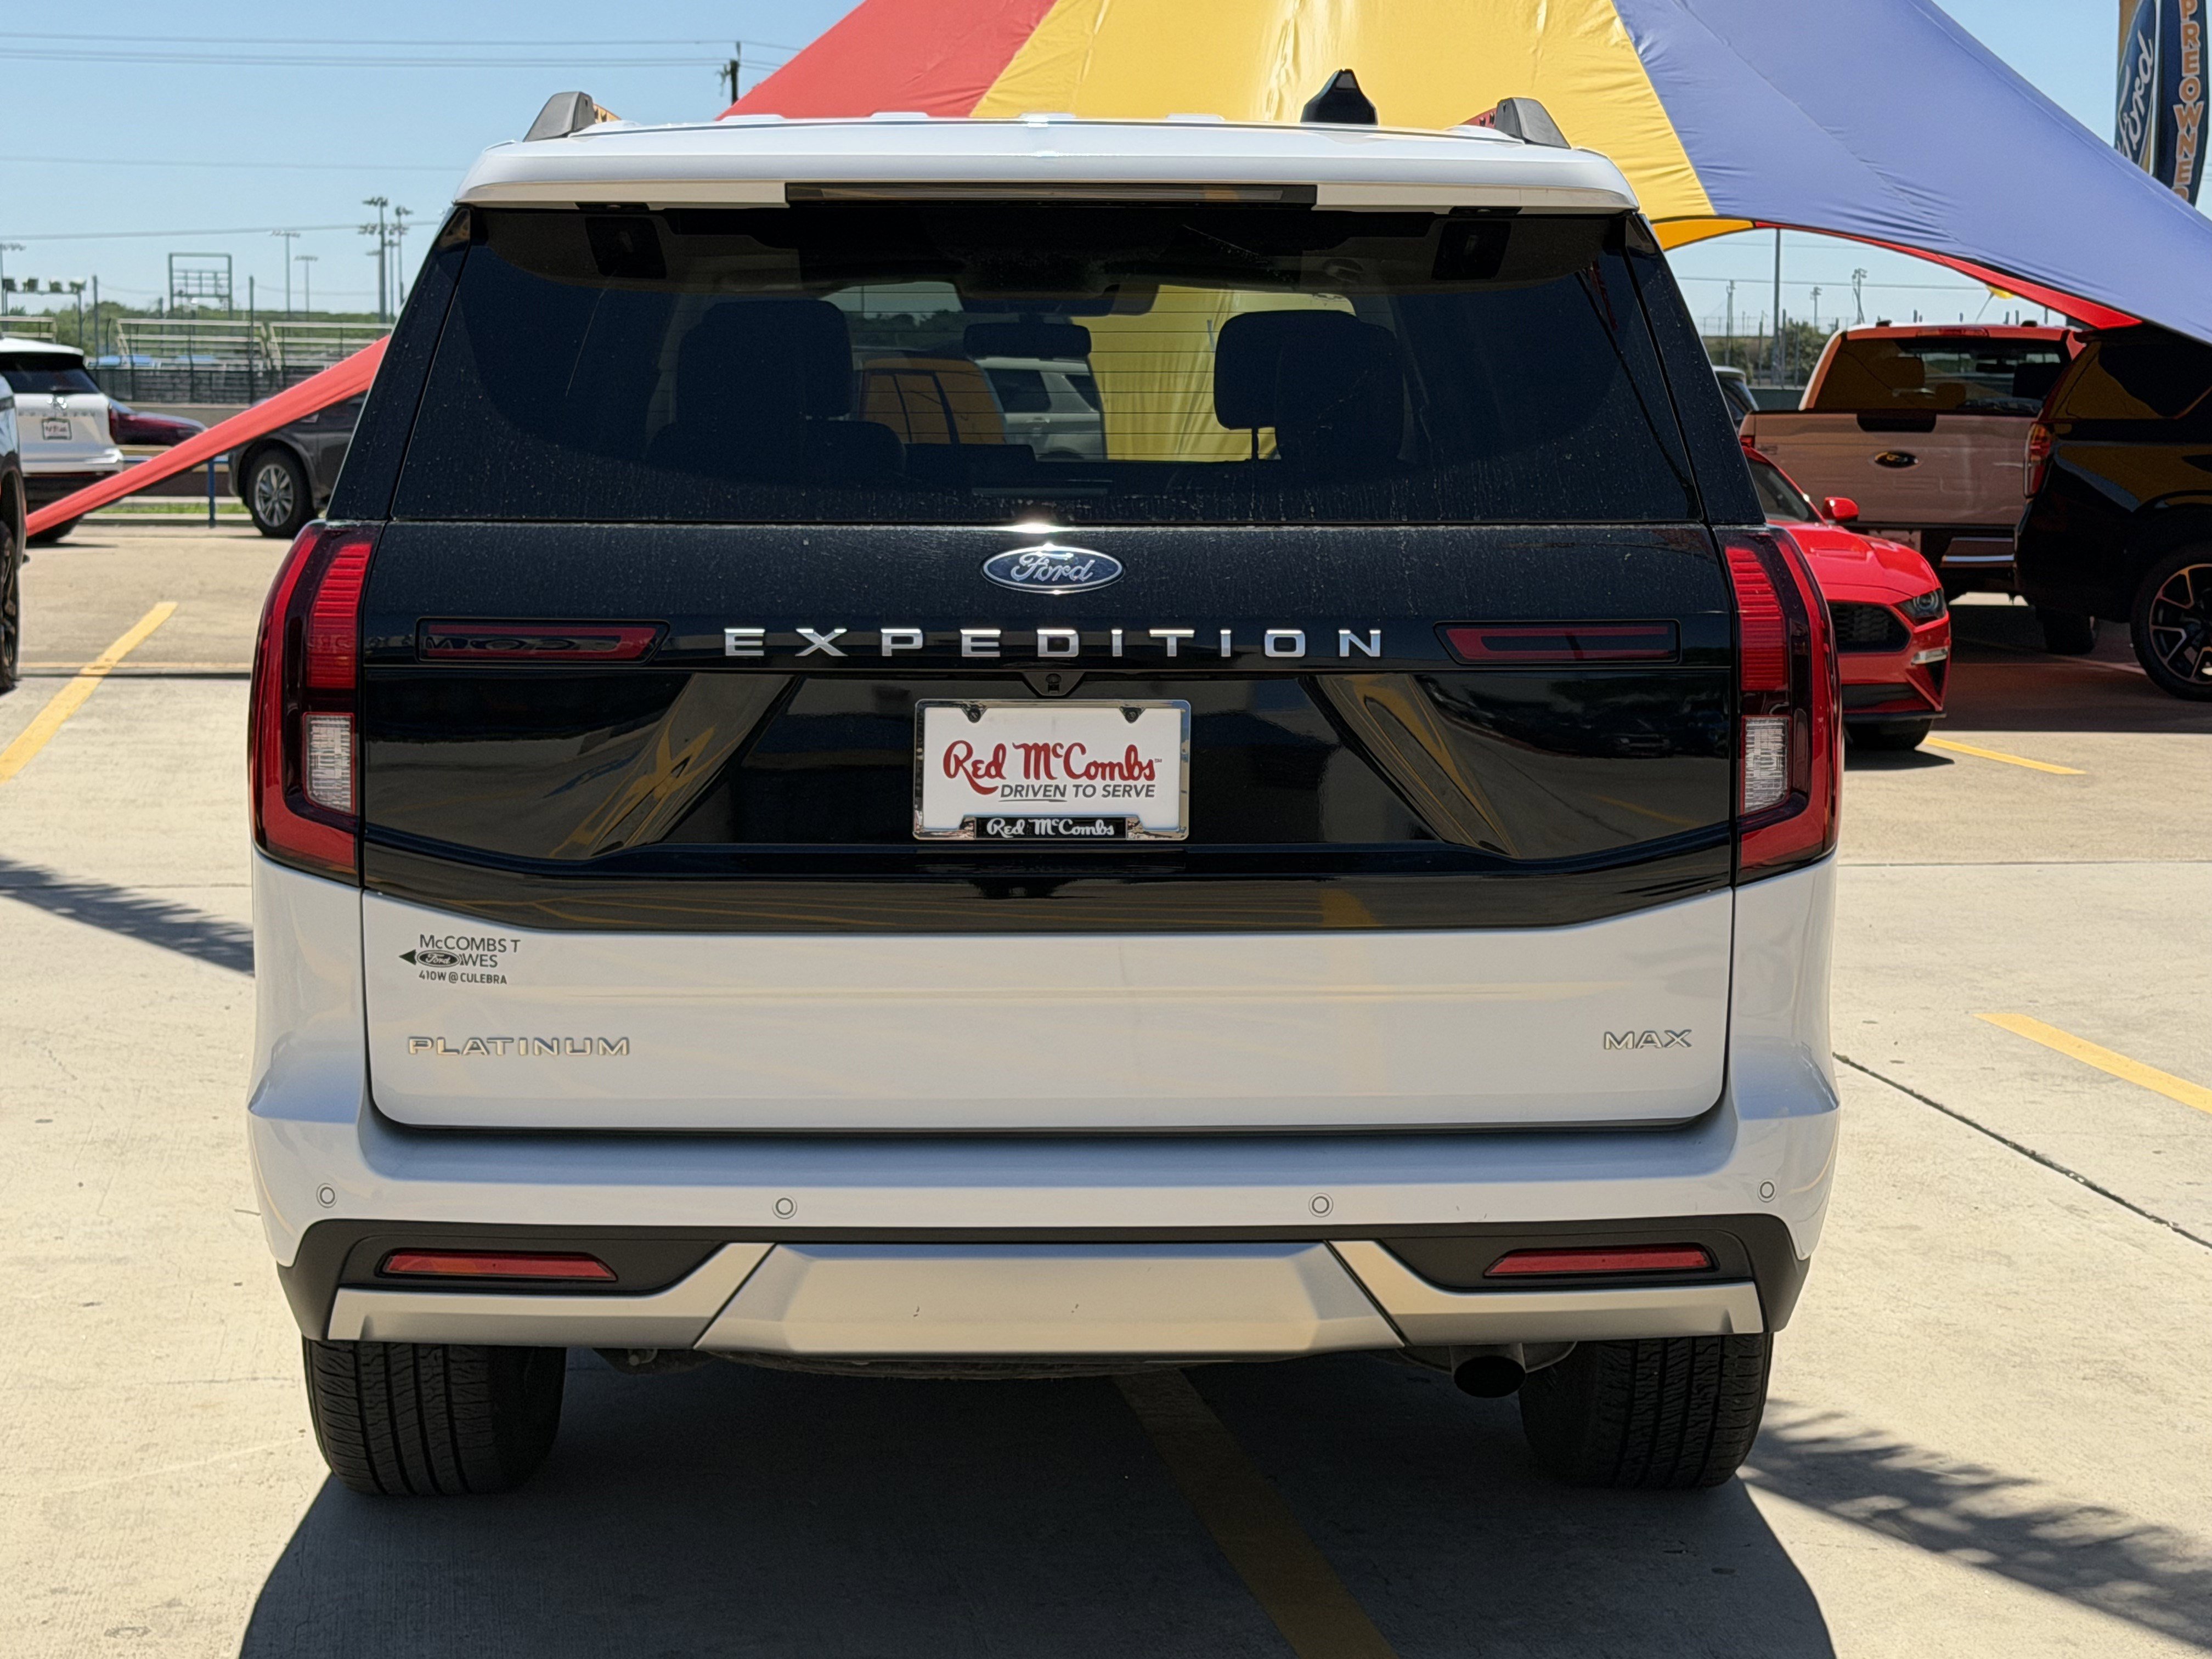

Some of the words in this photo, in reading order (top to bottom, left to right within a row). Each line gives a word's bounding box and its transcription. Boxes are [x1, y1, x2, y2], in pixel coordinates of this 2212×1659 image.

[2116, 30, 2153, 163] Ford
[1011, 551, 1095, 582] Ford
[723, 627, 1383, 658] EXPEDITION
[943, 739, 1007, 795] Red
[1000, 784, 1067, 798] DRIVEN
[1073, 784, 1096, 798] TO
[1101, 784, 1156, 798] SERVE
[986, 817, 1025, 838] Red
[1028, 818, 1114, 836] McCombs
[420, 934, 507, 953] McCOMBS
[425, 952, 450, 964] Ford
[460, 972, 507, 985] CULEBRA
[408, 1036, 630, 1056] PLATINUM
[1604, 1029, 1692, 1049] MAX
